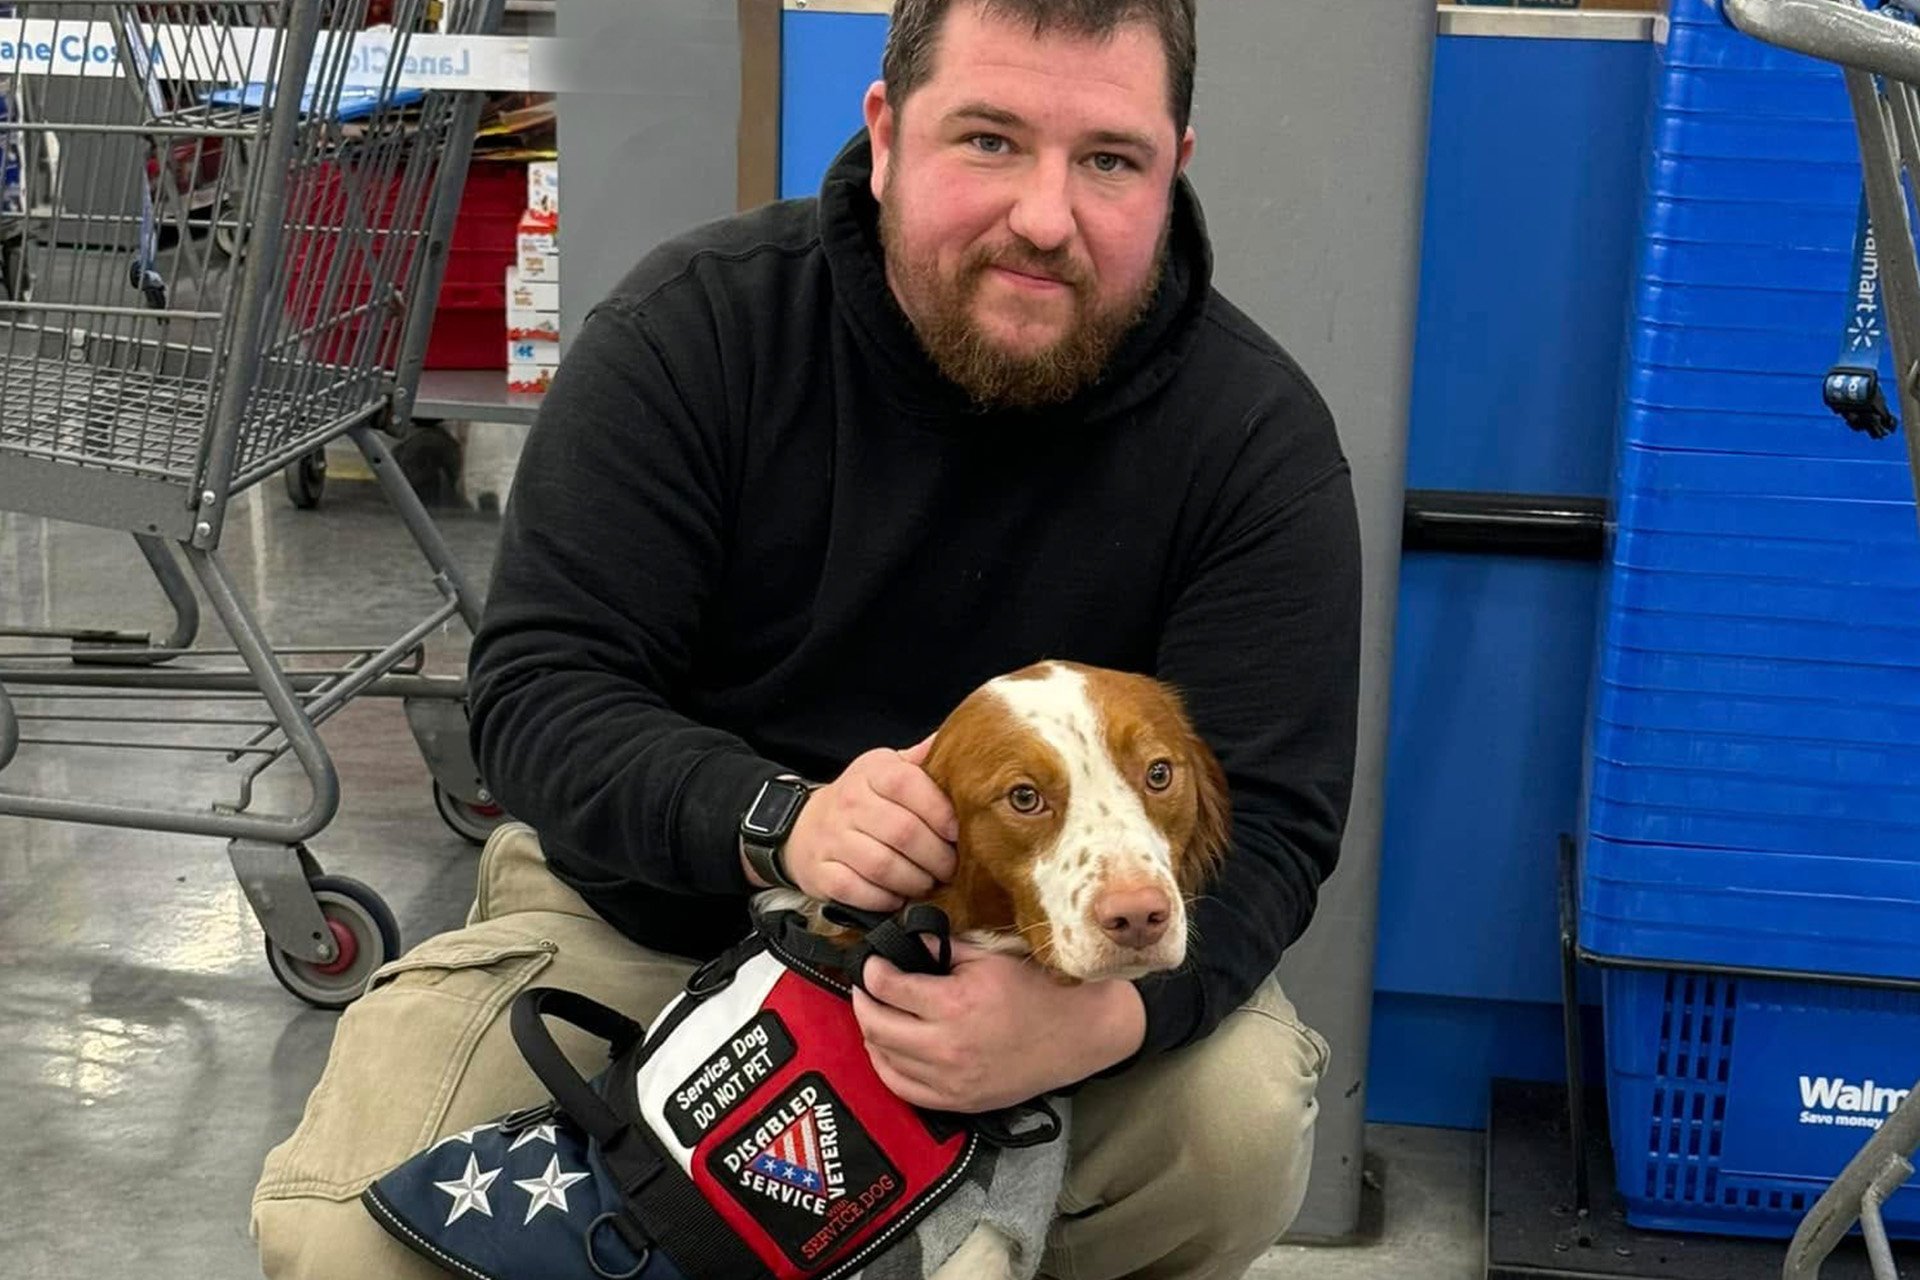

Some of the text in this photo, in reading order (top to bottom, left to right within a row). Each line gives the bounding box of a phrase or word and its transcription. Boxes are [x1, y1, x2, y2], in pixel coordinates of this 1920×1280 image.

[0, 39, 50, 60] ane
[1856, 218, 1878, 313] almart
[676, 1024, 769, 1110] Service Dog
[693, 1047, 773, 1129] DO NOT PET
[1799, 1076, 1910, 1113] Walm
[723, 1086, 818, 1173] DISABLED
[813, 1103, 846, 1200] VETERAN
[1799, 1111, 1833, 1125] Save
[740, 1170, 827, 1216] SERVICE
[801, 1174, 895, 1259] SERVICE DOG
